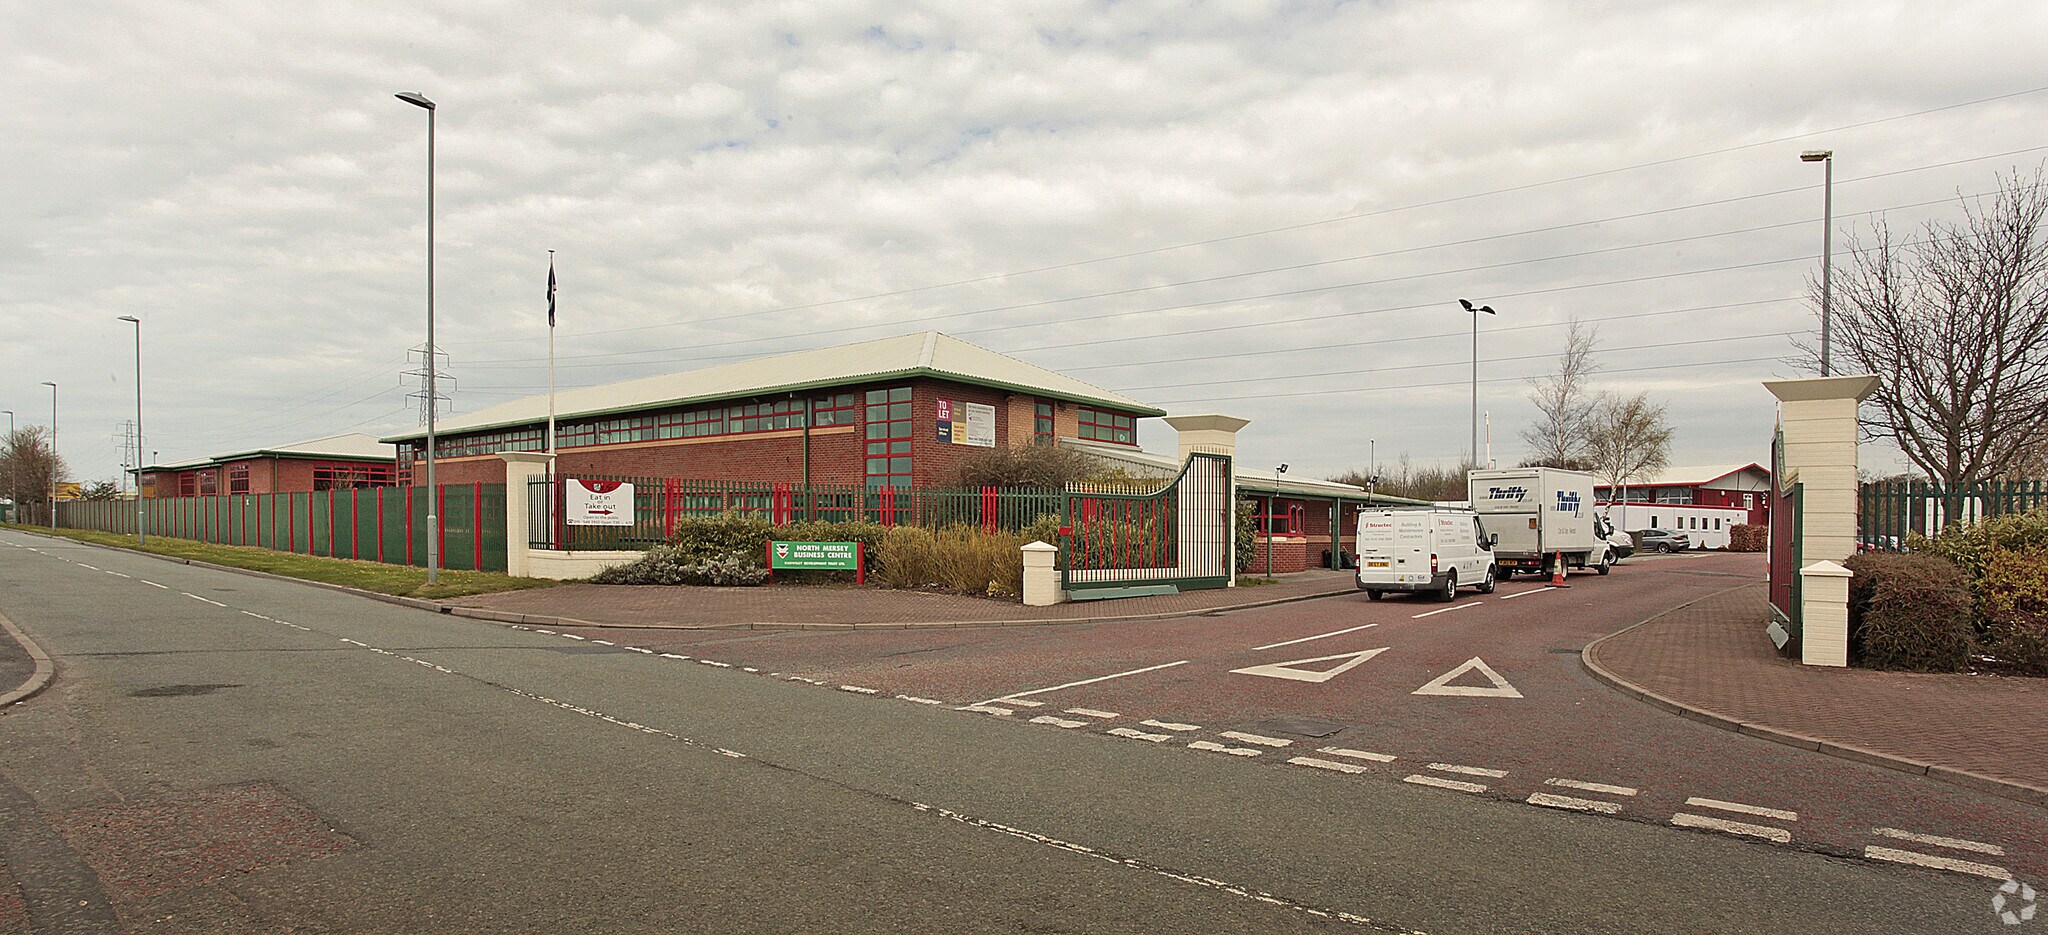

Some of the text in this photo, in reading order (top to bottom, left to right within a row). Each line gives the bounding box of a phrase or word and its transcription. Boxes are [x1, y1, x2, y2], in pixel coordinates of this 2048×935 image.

[938, 400, 946, 410] TO
[938, 410, 950, 419] LET
[1489, 486, 1528, 502] Thrifty
[1557, 491, 1581, 518] Thrifty
